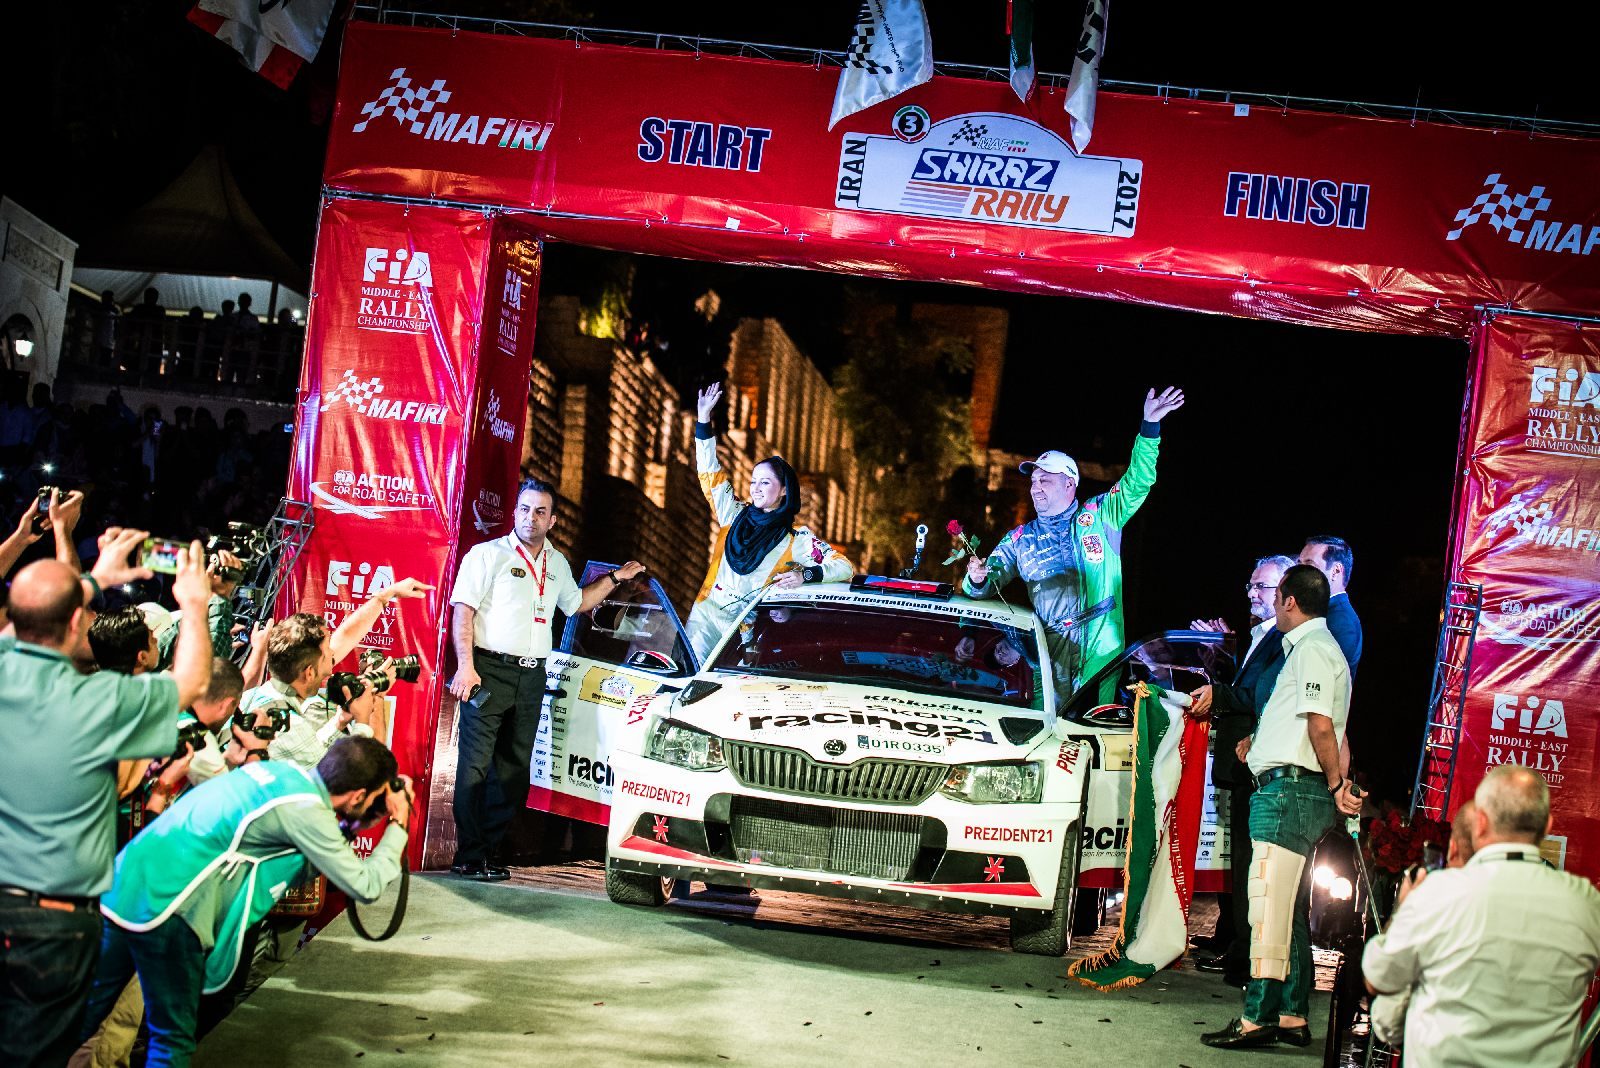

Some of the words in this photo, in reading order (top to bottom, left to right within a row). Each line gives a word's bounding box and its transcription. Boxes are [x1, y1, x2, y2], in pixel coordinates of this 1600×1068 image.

[424, 111, 555, 152] MAFIRI
[903, 115, 920, 134] 3
[637, 116, 771, 172] START
[838, 140, 866, 201] IRAN
[914, 151, 1056, 191] SHIRAZ
[1114, 171, 1140, 228] 2017
[1224, 171, 1370, 230] FINISH
[361, 287, 400, 298] MIDDLE
[358, 298, 431, 320] RALLY
[357, 316, 430, 330] CHAMPIONSHIP
[367, 399, 448, 424] MAFIRI
[1528, 408, 1571, 420] MIDDLE
[1526, 419, 1600, 443] RALLY
[357, 473, 414, 491] ACTION
[333, 486, 350, 494] FOR
[352, 488, 386, 501] ROAD
[388, 491, 435, 506] SAFETY
[814, 594, 851, 602] Shiraz
[853, 595, 932, 611] International
[934, 604, 965, 616] Rally
[966, 609, 993, 620] 2017
[1526, 603, 1586, 622] ACTION
[1519, 616, 1556, 632] ROAD
[749, 708, 999, 745] racing21
[902, 741, 942, 754] 0335
[1489, 734, 1532, 748] MIDDLE
[1540, 741, 1569, 753] EAST
[1486, 746, 1566, 773] RALLY
[621, 779, 692, 807] PREZIDENT21
[964, 825, 1054, 844] PREZIDENT21
